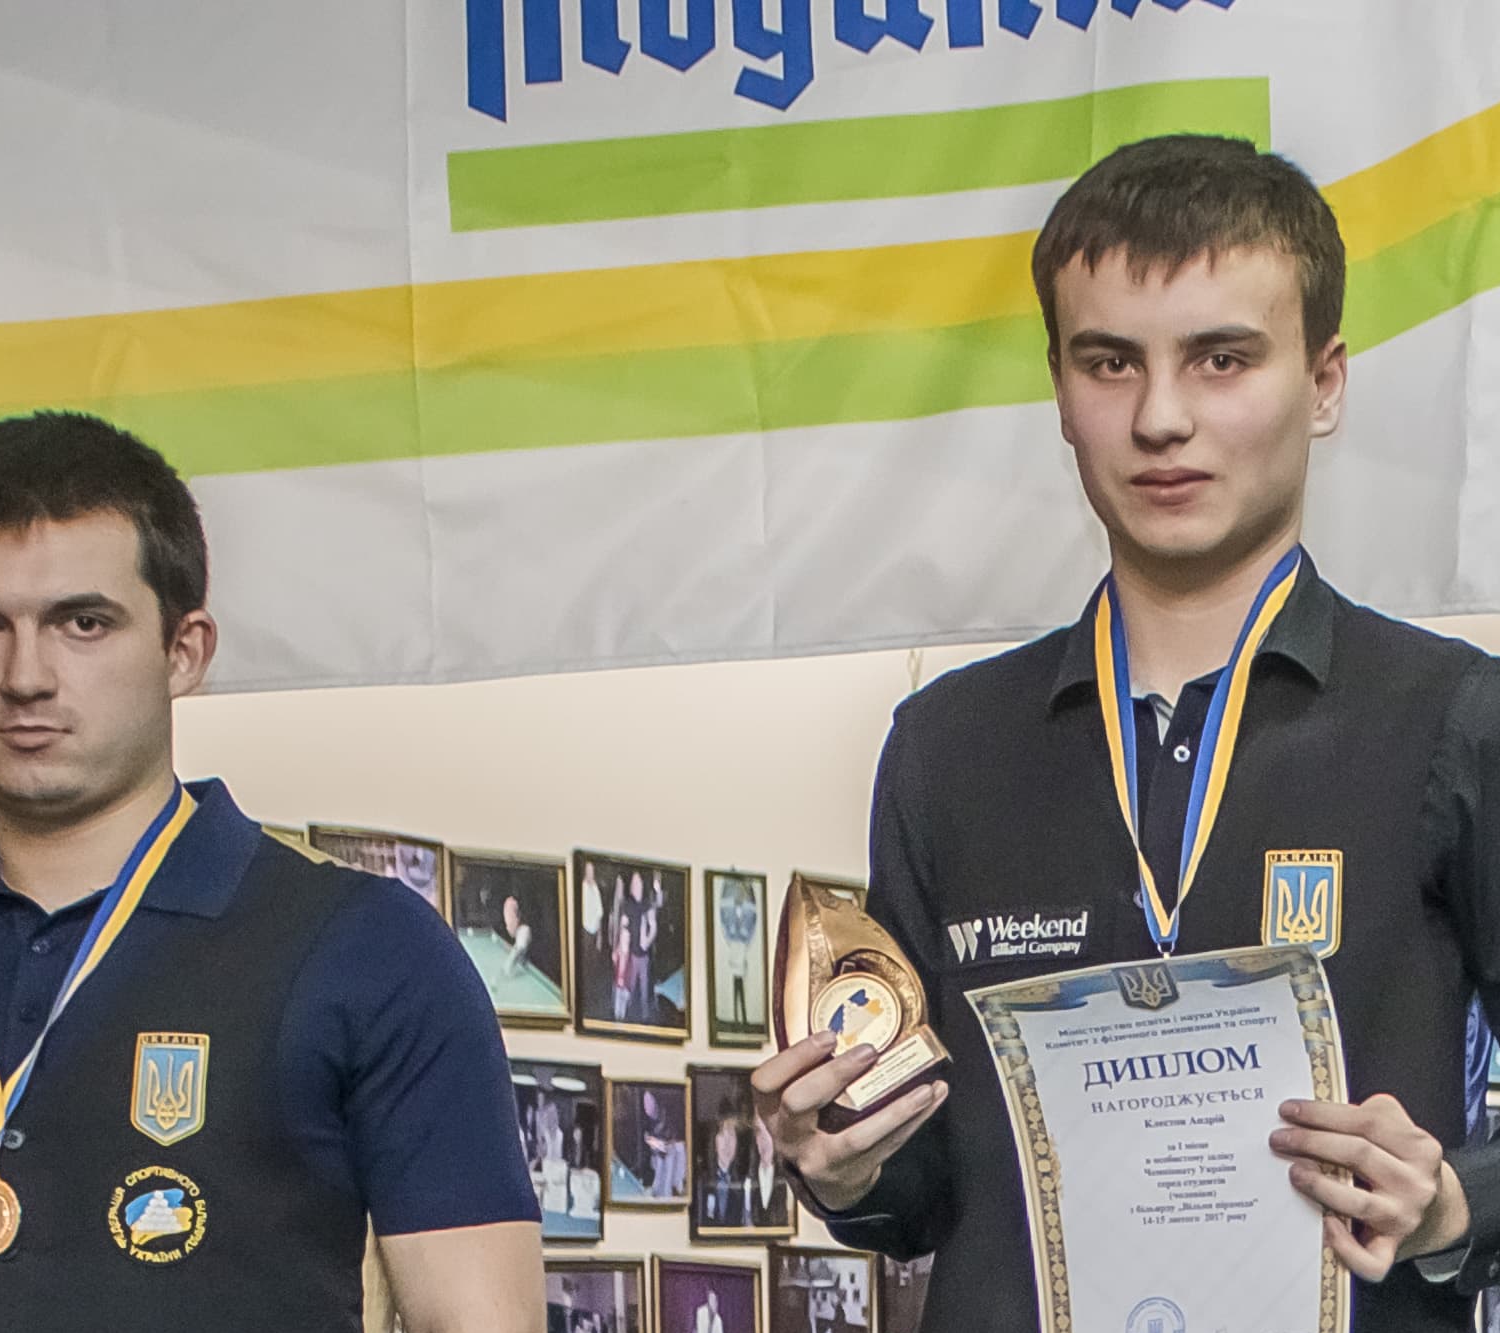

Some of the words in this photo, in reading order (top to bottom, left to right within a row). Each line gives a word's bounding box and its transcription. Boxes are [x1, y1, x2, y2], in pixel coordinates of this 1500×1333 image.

[987, 911, 1088, 942] Weekend
[1028, 941, 1081, 956] Company
[1083, 1043, 1262, 1092] ДИПЛОМ
[1092, 1087, 1264, 1114] НАГОРОДЖУЄТЬСЯ
